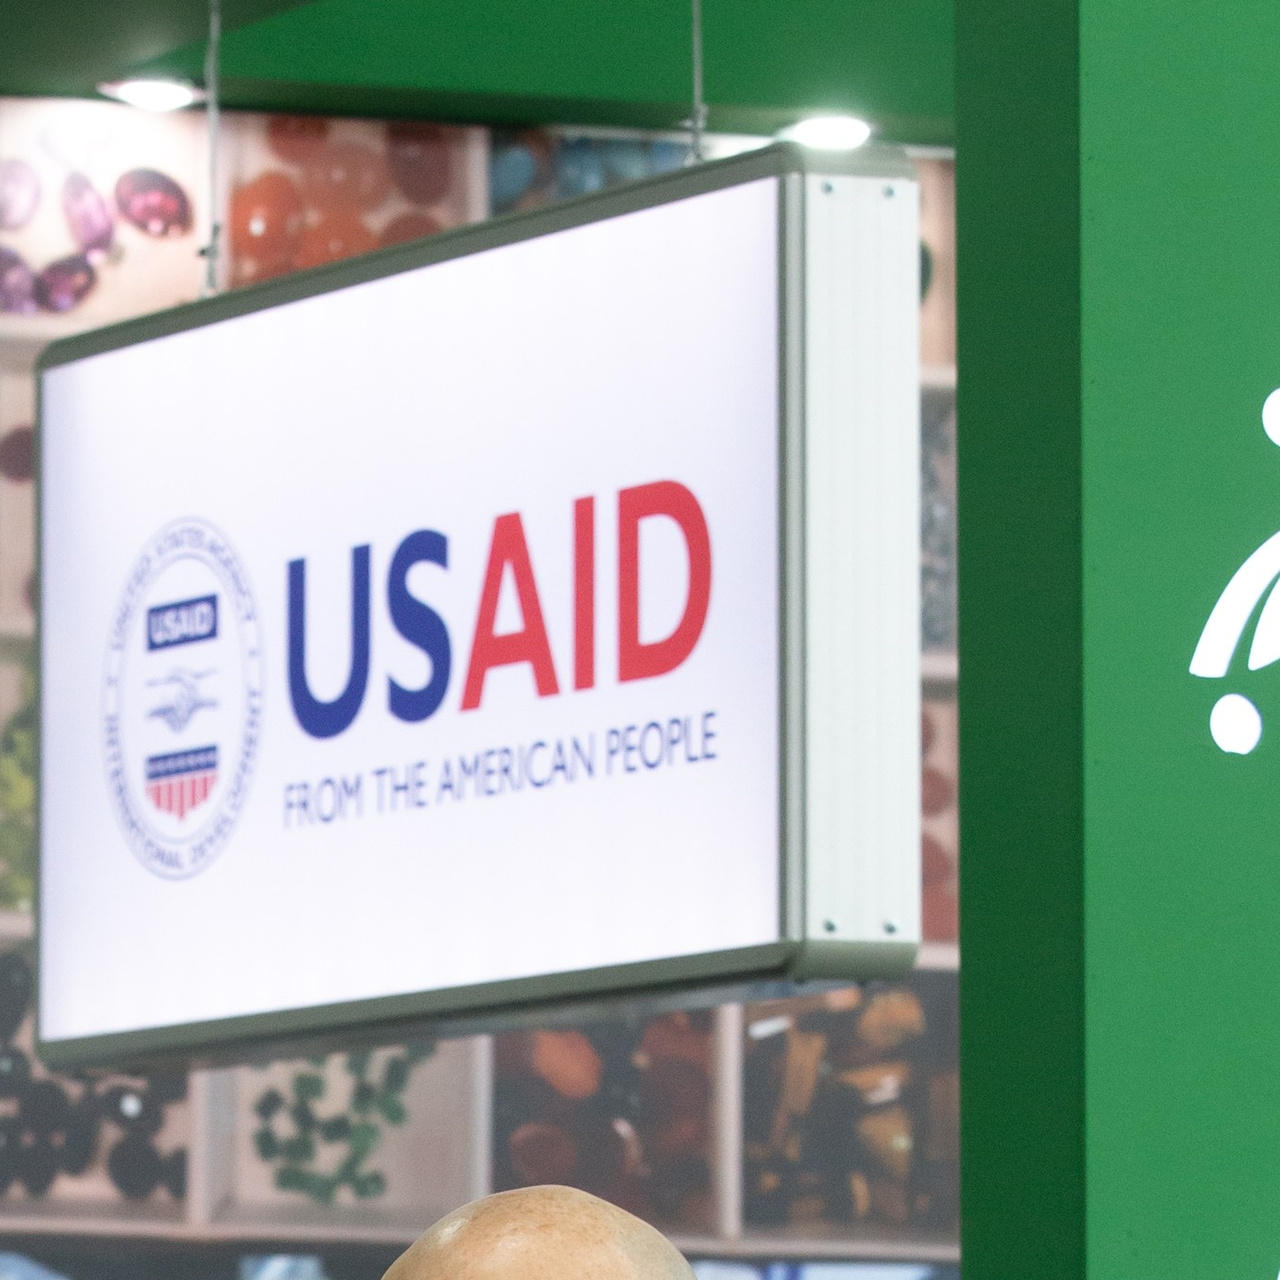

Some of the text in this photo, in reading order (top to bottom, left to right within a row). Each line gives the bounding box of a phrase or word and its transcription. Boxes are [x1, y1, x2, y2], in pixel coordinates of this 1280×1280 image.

[151, 602, 214, 645] USAID
[286, 479, 713, 740] USAID
[283, 711, 718, 830] FROM THE AMERICAN PEOPLE
